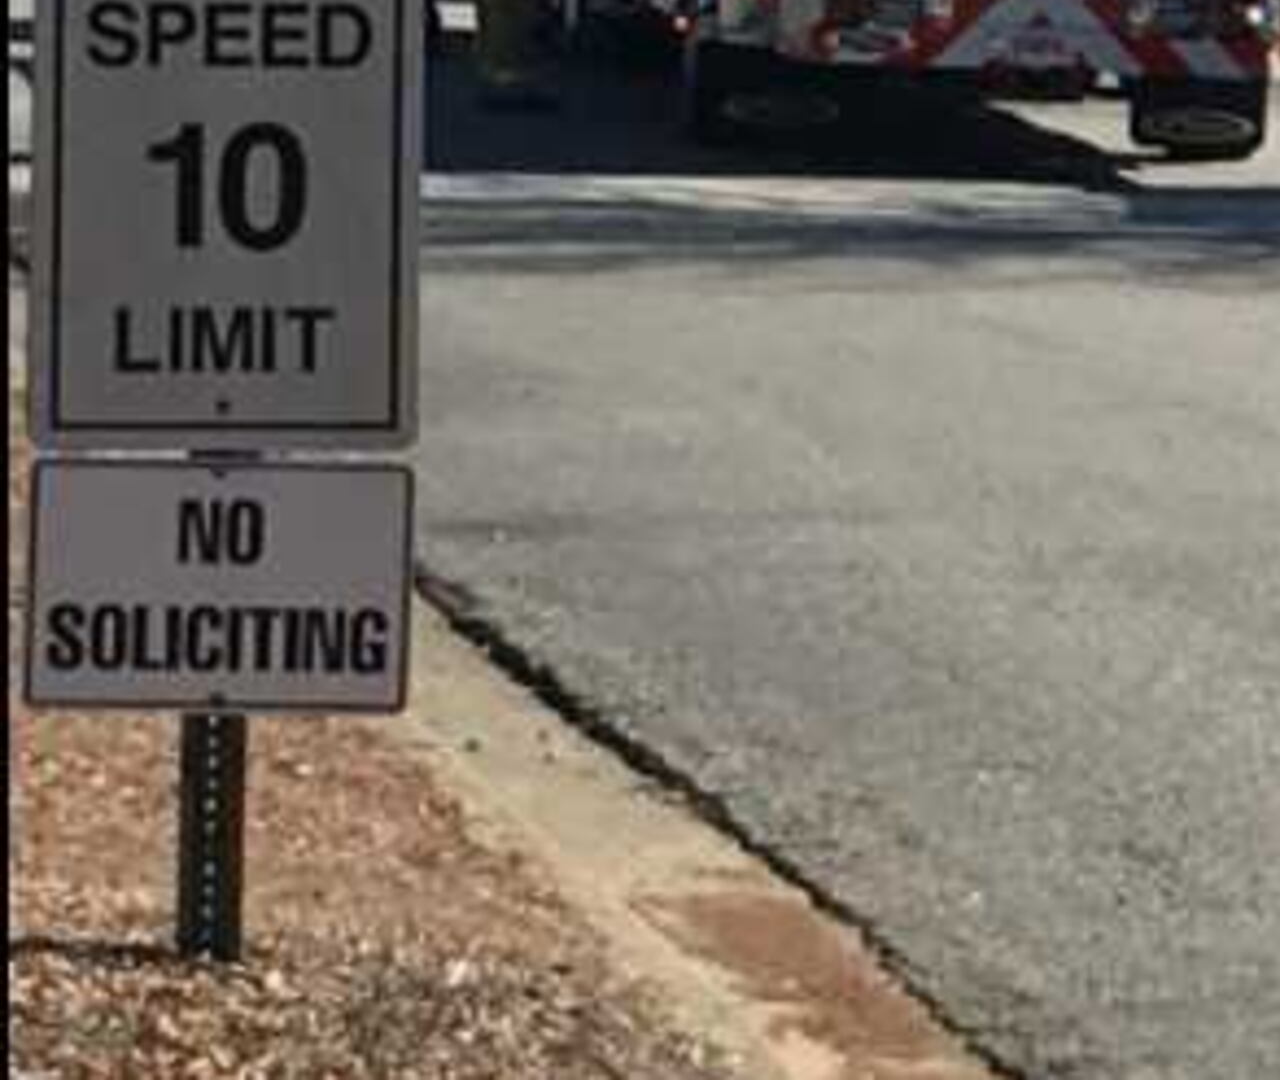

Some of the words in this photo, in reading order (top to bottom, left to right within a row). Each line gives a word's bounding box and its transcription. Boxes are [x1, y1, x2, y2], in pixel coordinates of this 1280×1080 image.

[87, 0, 373, 68] SPEED
[147, 121, 308, 252] 10
[114, 306, 336, 372] LIMIT
[176, 497, 265, 565] NO
[46, 602, 388, 674] SOLICITING
